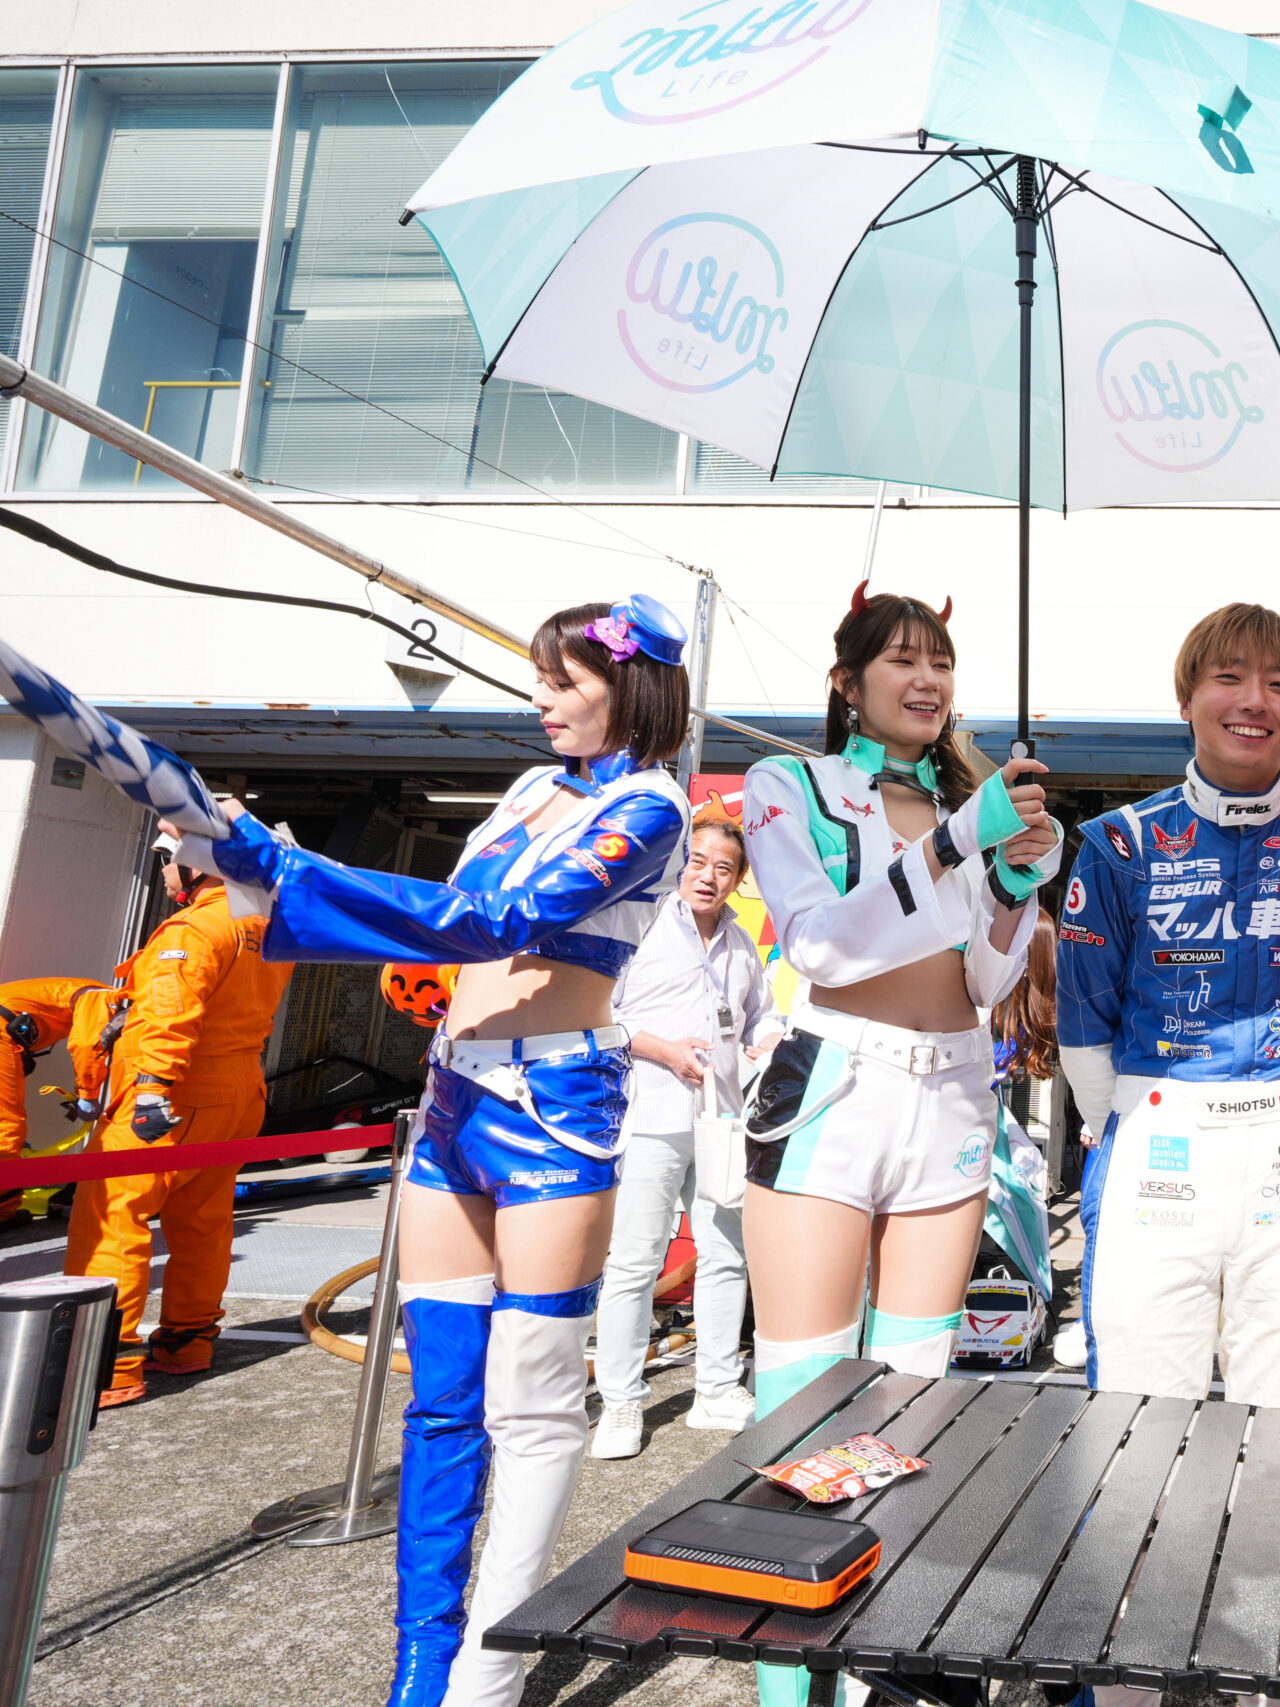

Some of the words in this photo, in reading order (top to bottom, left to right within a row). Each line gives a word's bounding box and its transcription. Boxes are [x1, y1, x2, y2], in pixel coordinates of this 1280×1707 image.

[661, 69, 748, 98] Life
[407, 619, 437, 661] 2
[1225, 803, 1271, 817] Firelex
[598, 836, 624, 858] 5
[1151, 858, 1221, 876] BPS
[1068, 882, 1079, 909] 5
[1149, 880, 1223, 900] ESPELIR
[1060, 929, 1105, 946] ach
[1170, 952, 1221, 962] YOKOHAMA
[1206, 1096, 1276, 1113] Y.SHIOTSU
[1139, 1180, 1196, 1200] VERSUS
